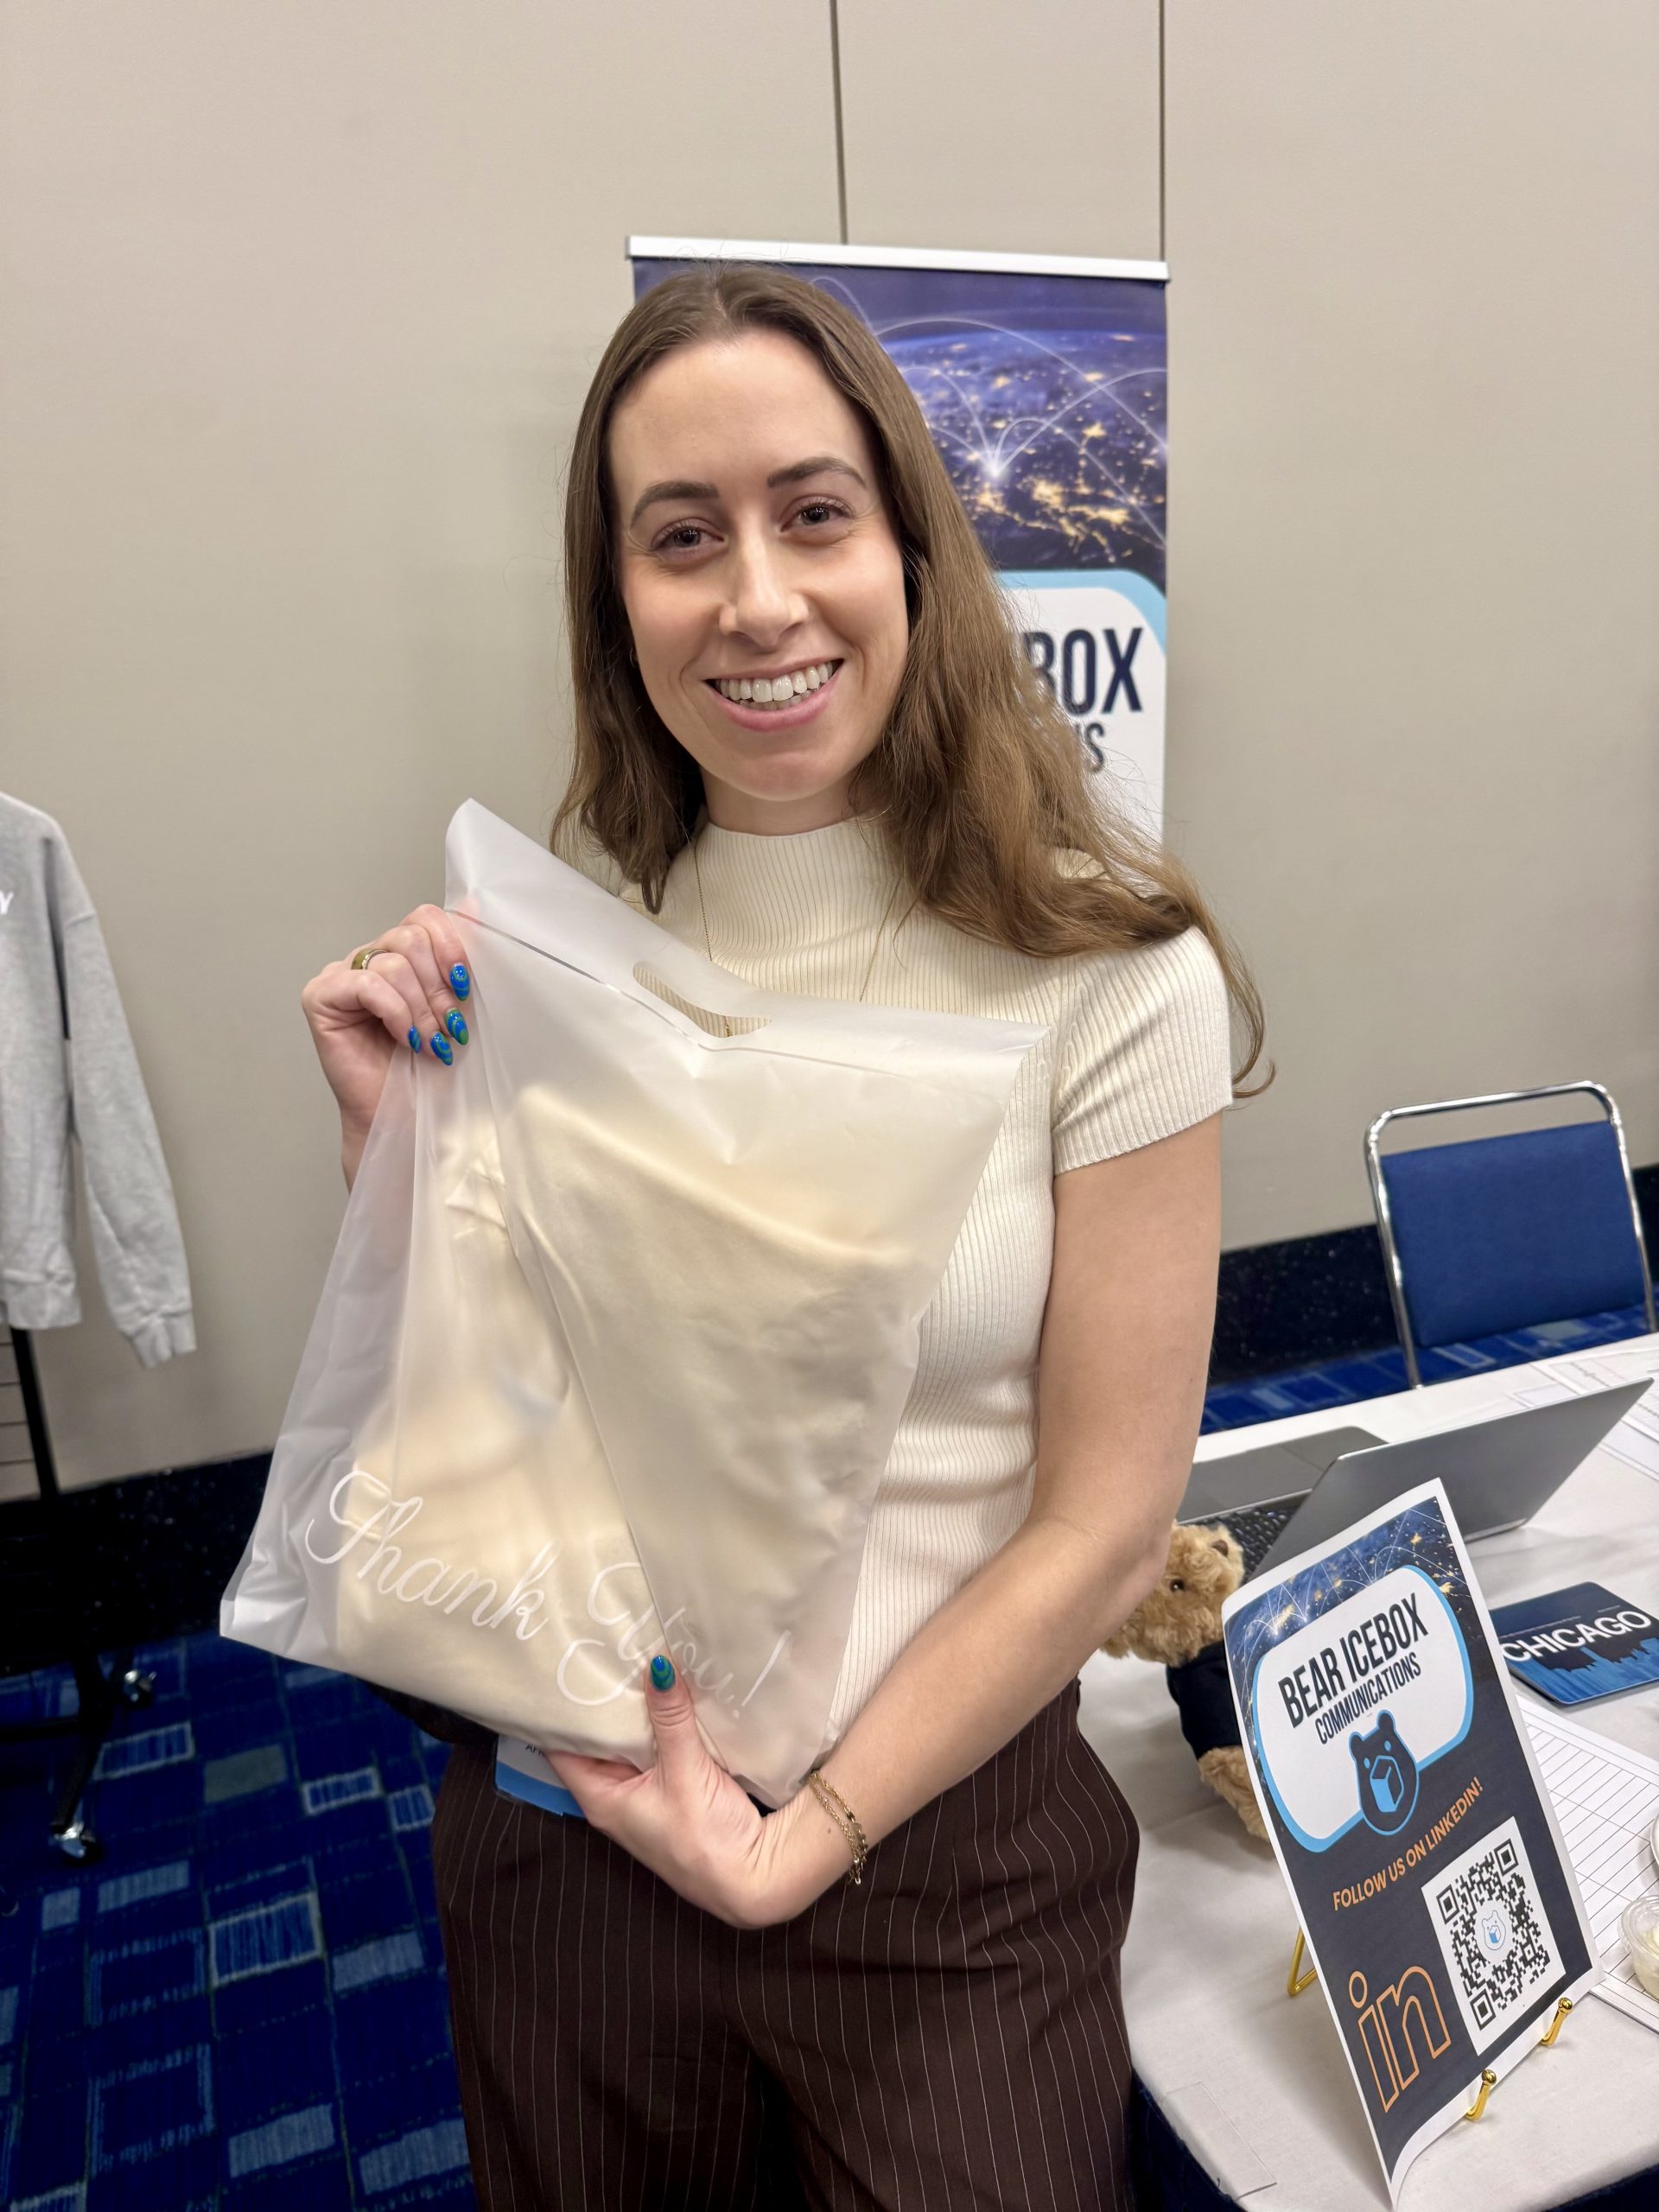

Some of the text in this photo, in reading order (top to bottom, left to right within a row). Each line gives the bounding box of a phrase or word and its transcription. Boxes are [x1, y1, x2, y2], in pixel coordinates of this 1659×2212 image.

[305, 1469, 562, 1641] Thank
[1277, 1592, 1429, 1729] BEAR ICEBOX
[1314, 1651, 1421, 1745] COMMUNICATIONS
[1500, 1611, 1652, 1662] CHICAGO
[1332, 1776, 1484, 1911] FOLLOW US ON LINKEDIN!
[1348, 1966, 1452, 2113] in
